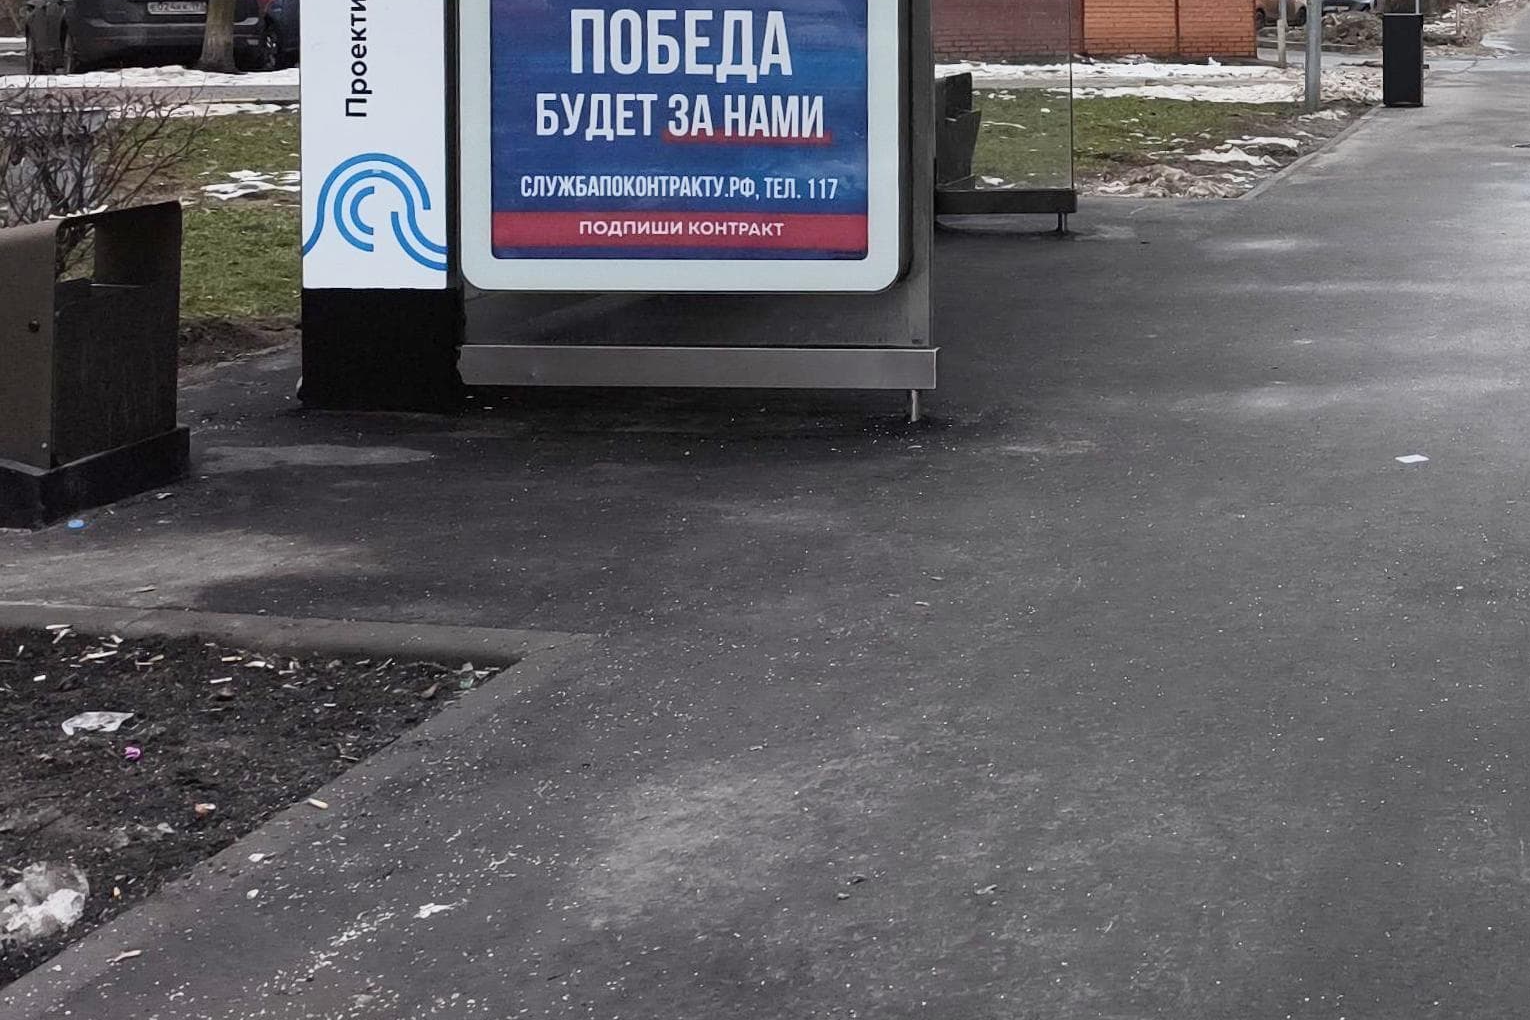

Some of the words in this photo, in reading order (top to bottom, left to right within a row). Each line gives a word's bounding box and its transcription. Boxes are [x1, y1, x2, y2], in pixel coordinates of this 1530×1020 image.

[570, 8, 793, 84] ПОБЕДА
[535, 93, 658, 141] БУДЕТ
[667, 93, 714, 137] ЗА
[724, 94, 824, 138] НАМИ
[520, 175, 760, 201] СЛУЖБАПОКОНТРАКТУ.РФ,
[764, 177, 801, 199] ТЕЛ.
[807, 178, 839, 200] 117
[579, 220, 683, 237] ПОДПИШИ
[688, 222, 785, 237] КОНТРАКТ
